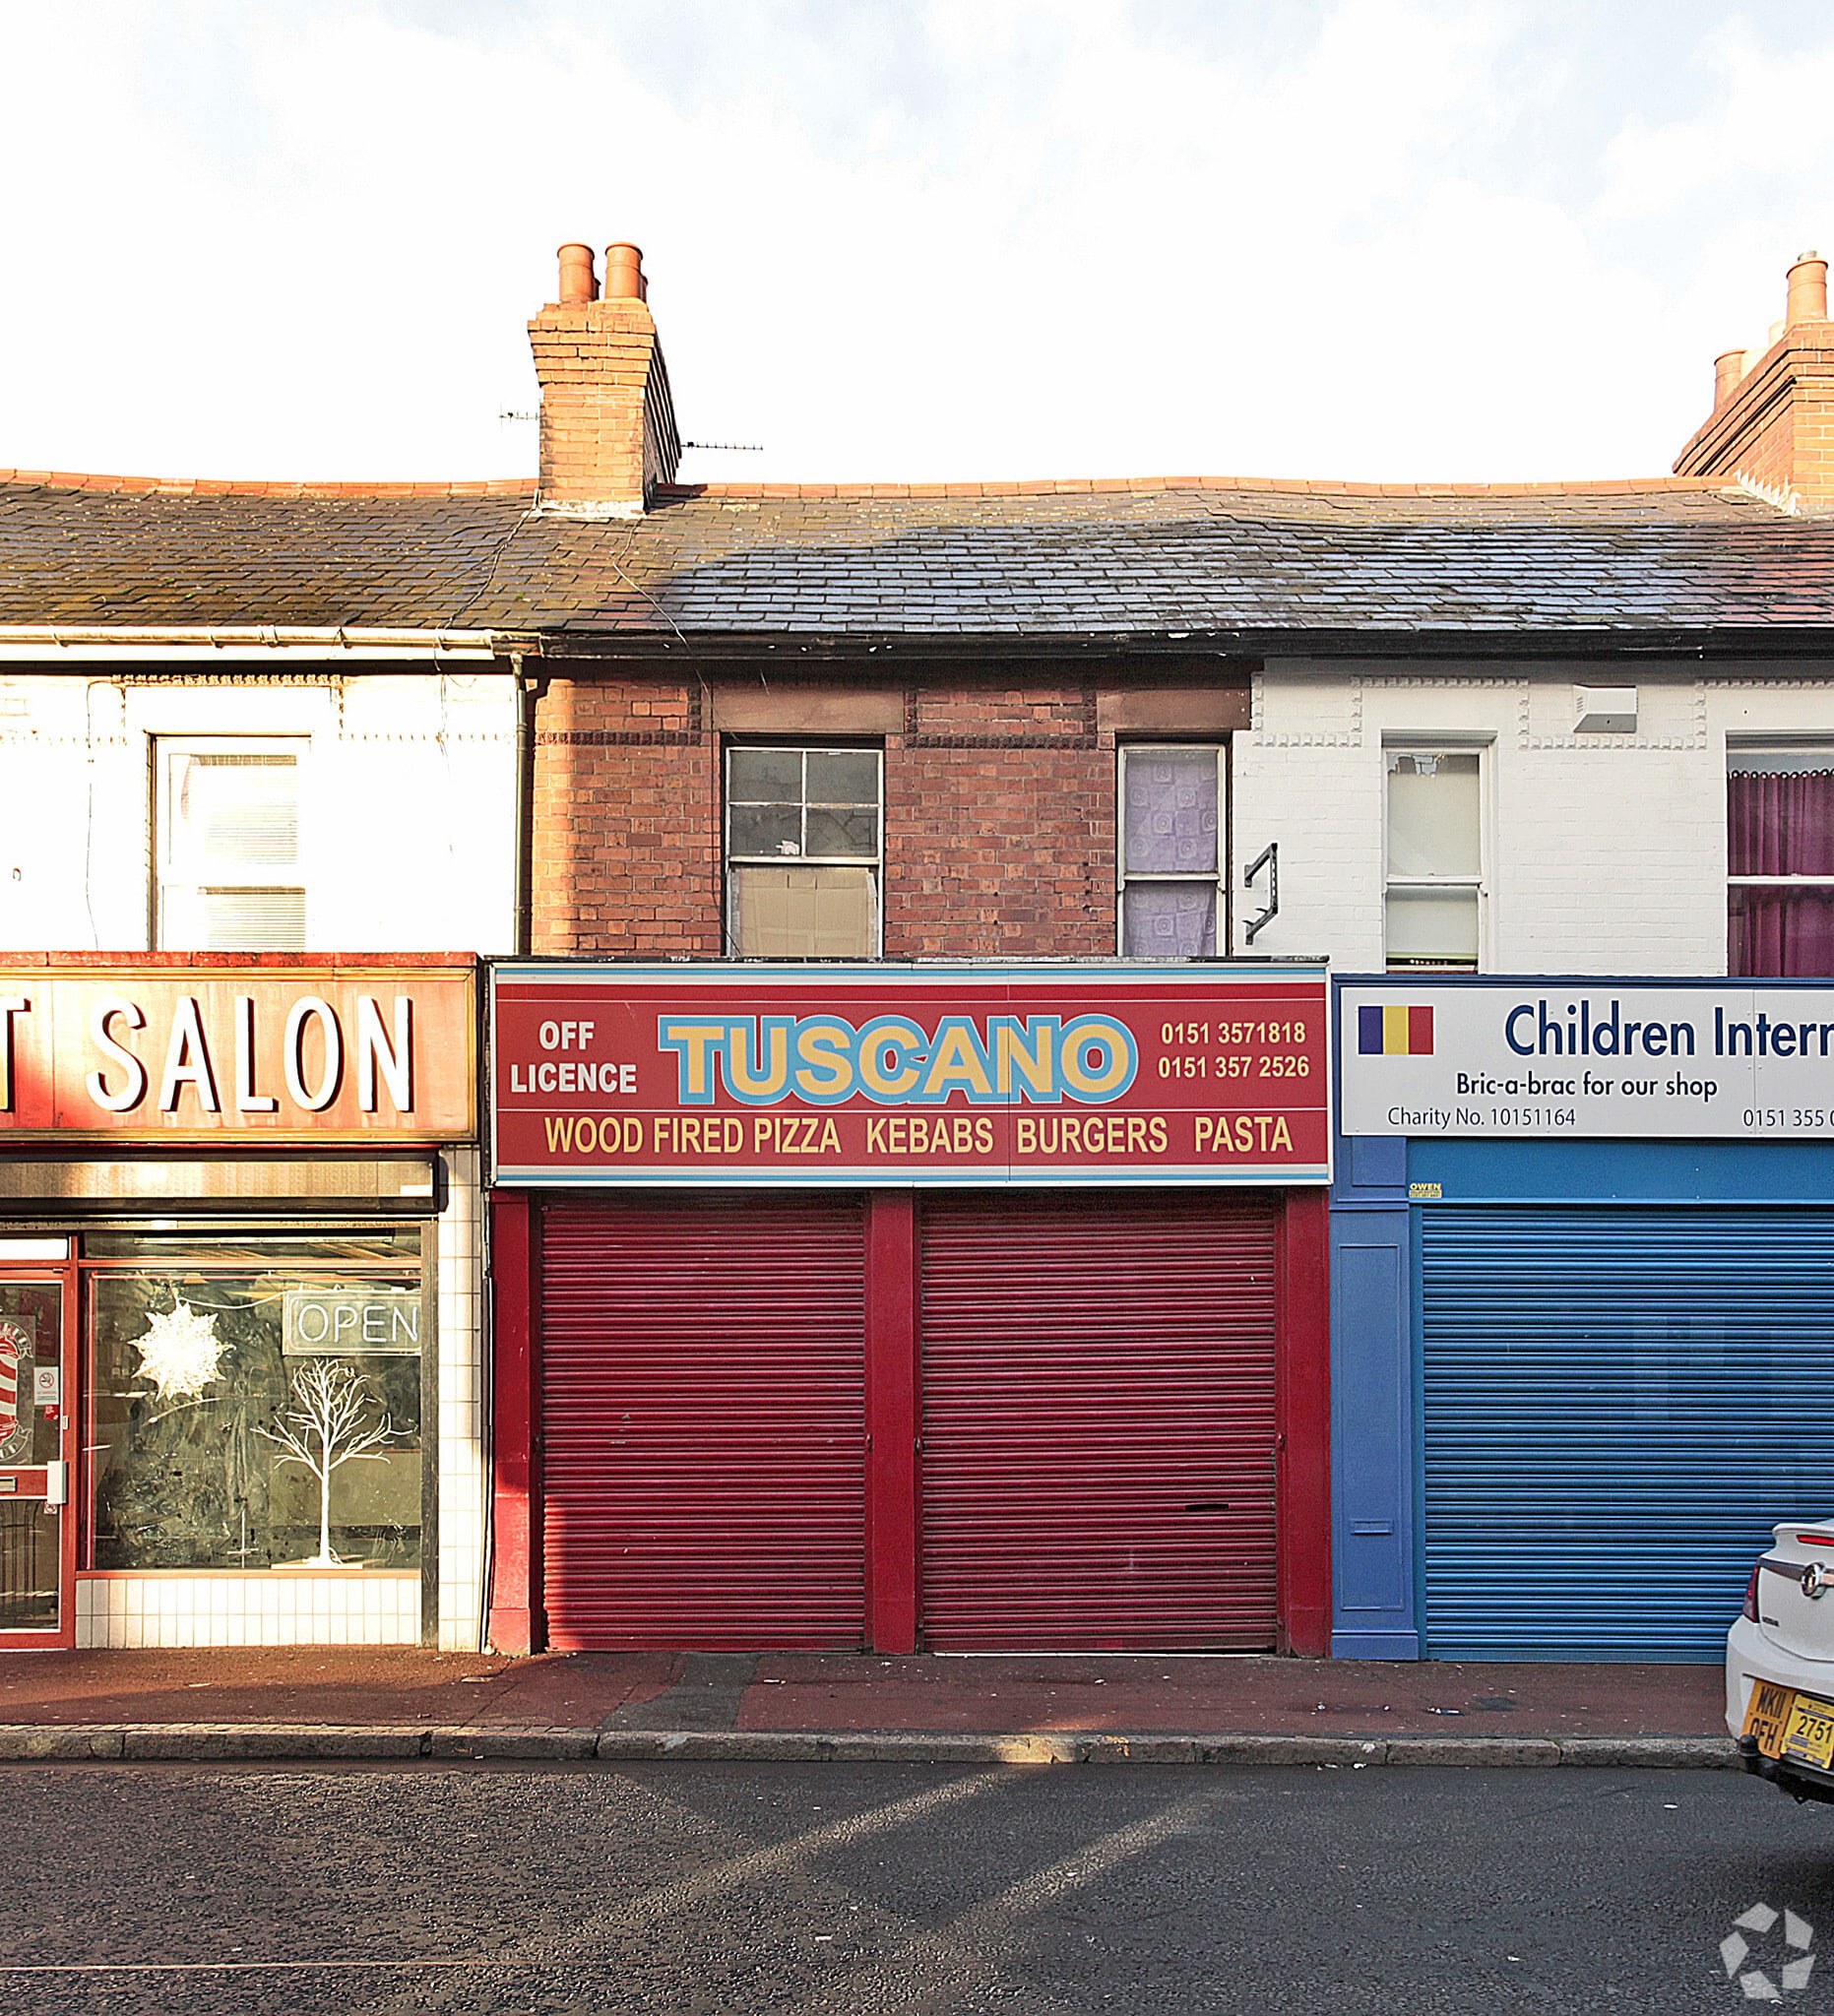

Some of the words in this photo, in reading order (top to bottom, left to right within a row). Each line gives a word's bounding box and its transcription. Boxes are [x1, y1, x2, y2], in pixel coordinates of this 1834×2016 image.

[539, 1021, 595, 1049] OFF
[1161, 1022, 1210, 1044] 0151
[1218, 1022, 1306, 1044] 3571818
[1505, 1000, 1695, 1056] Children
[86, 995, 414, 1113] SALON
[662, 1019, 1135, 1102] TUSCANO
[1158, 1056, 1207, 1079] 0151
[1215, 1056, 1253, 1078] 357
[1258, 1055, 1310, 1078] 2526
[511, 1063, 637, 1093] LICENCE
[1457, 1071, 1576, 1096] Bric-a-brac
[1583, 1071, 1614, 1096] for
[1621, 1080, 1659, 1096] our
[1666, 1071, 1718, 1102] shop
[1388, 1106, 1451, 1130] Charity
[1456, 1107, 1485, 1125] No.
[1491, 1108, 1575, 1126] 10151164
[1743, 1109, 1785, 1126] 0151
[1793, 1109, 1824, 1126] 355
[544, 1117, 644, 1154] WOOD
[654, 1118, 744, 1154] FIRED
[754, 1118, 842, 1154] PIZZA
[866, 1118, 993, 1154] KEBABS
[1018, 1117, 1169, 1153] BURGERS
[1194, 1116, 1294, 1152] PASTA
[1410, 1182, 1442, 1191] OWEN
[298, 1304, 418, 1343] OPEN
[1797, 1715, 1834, 1743] 2751
